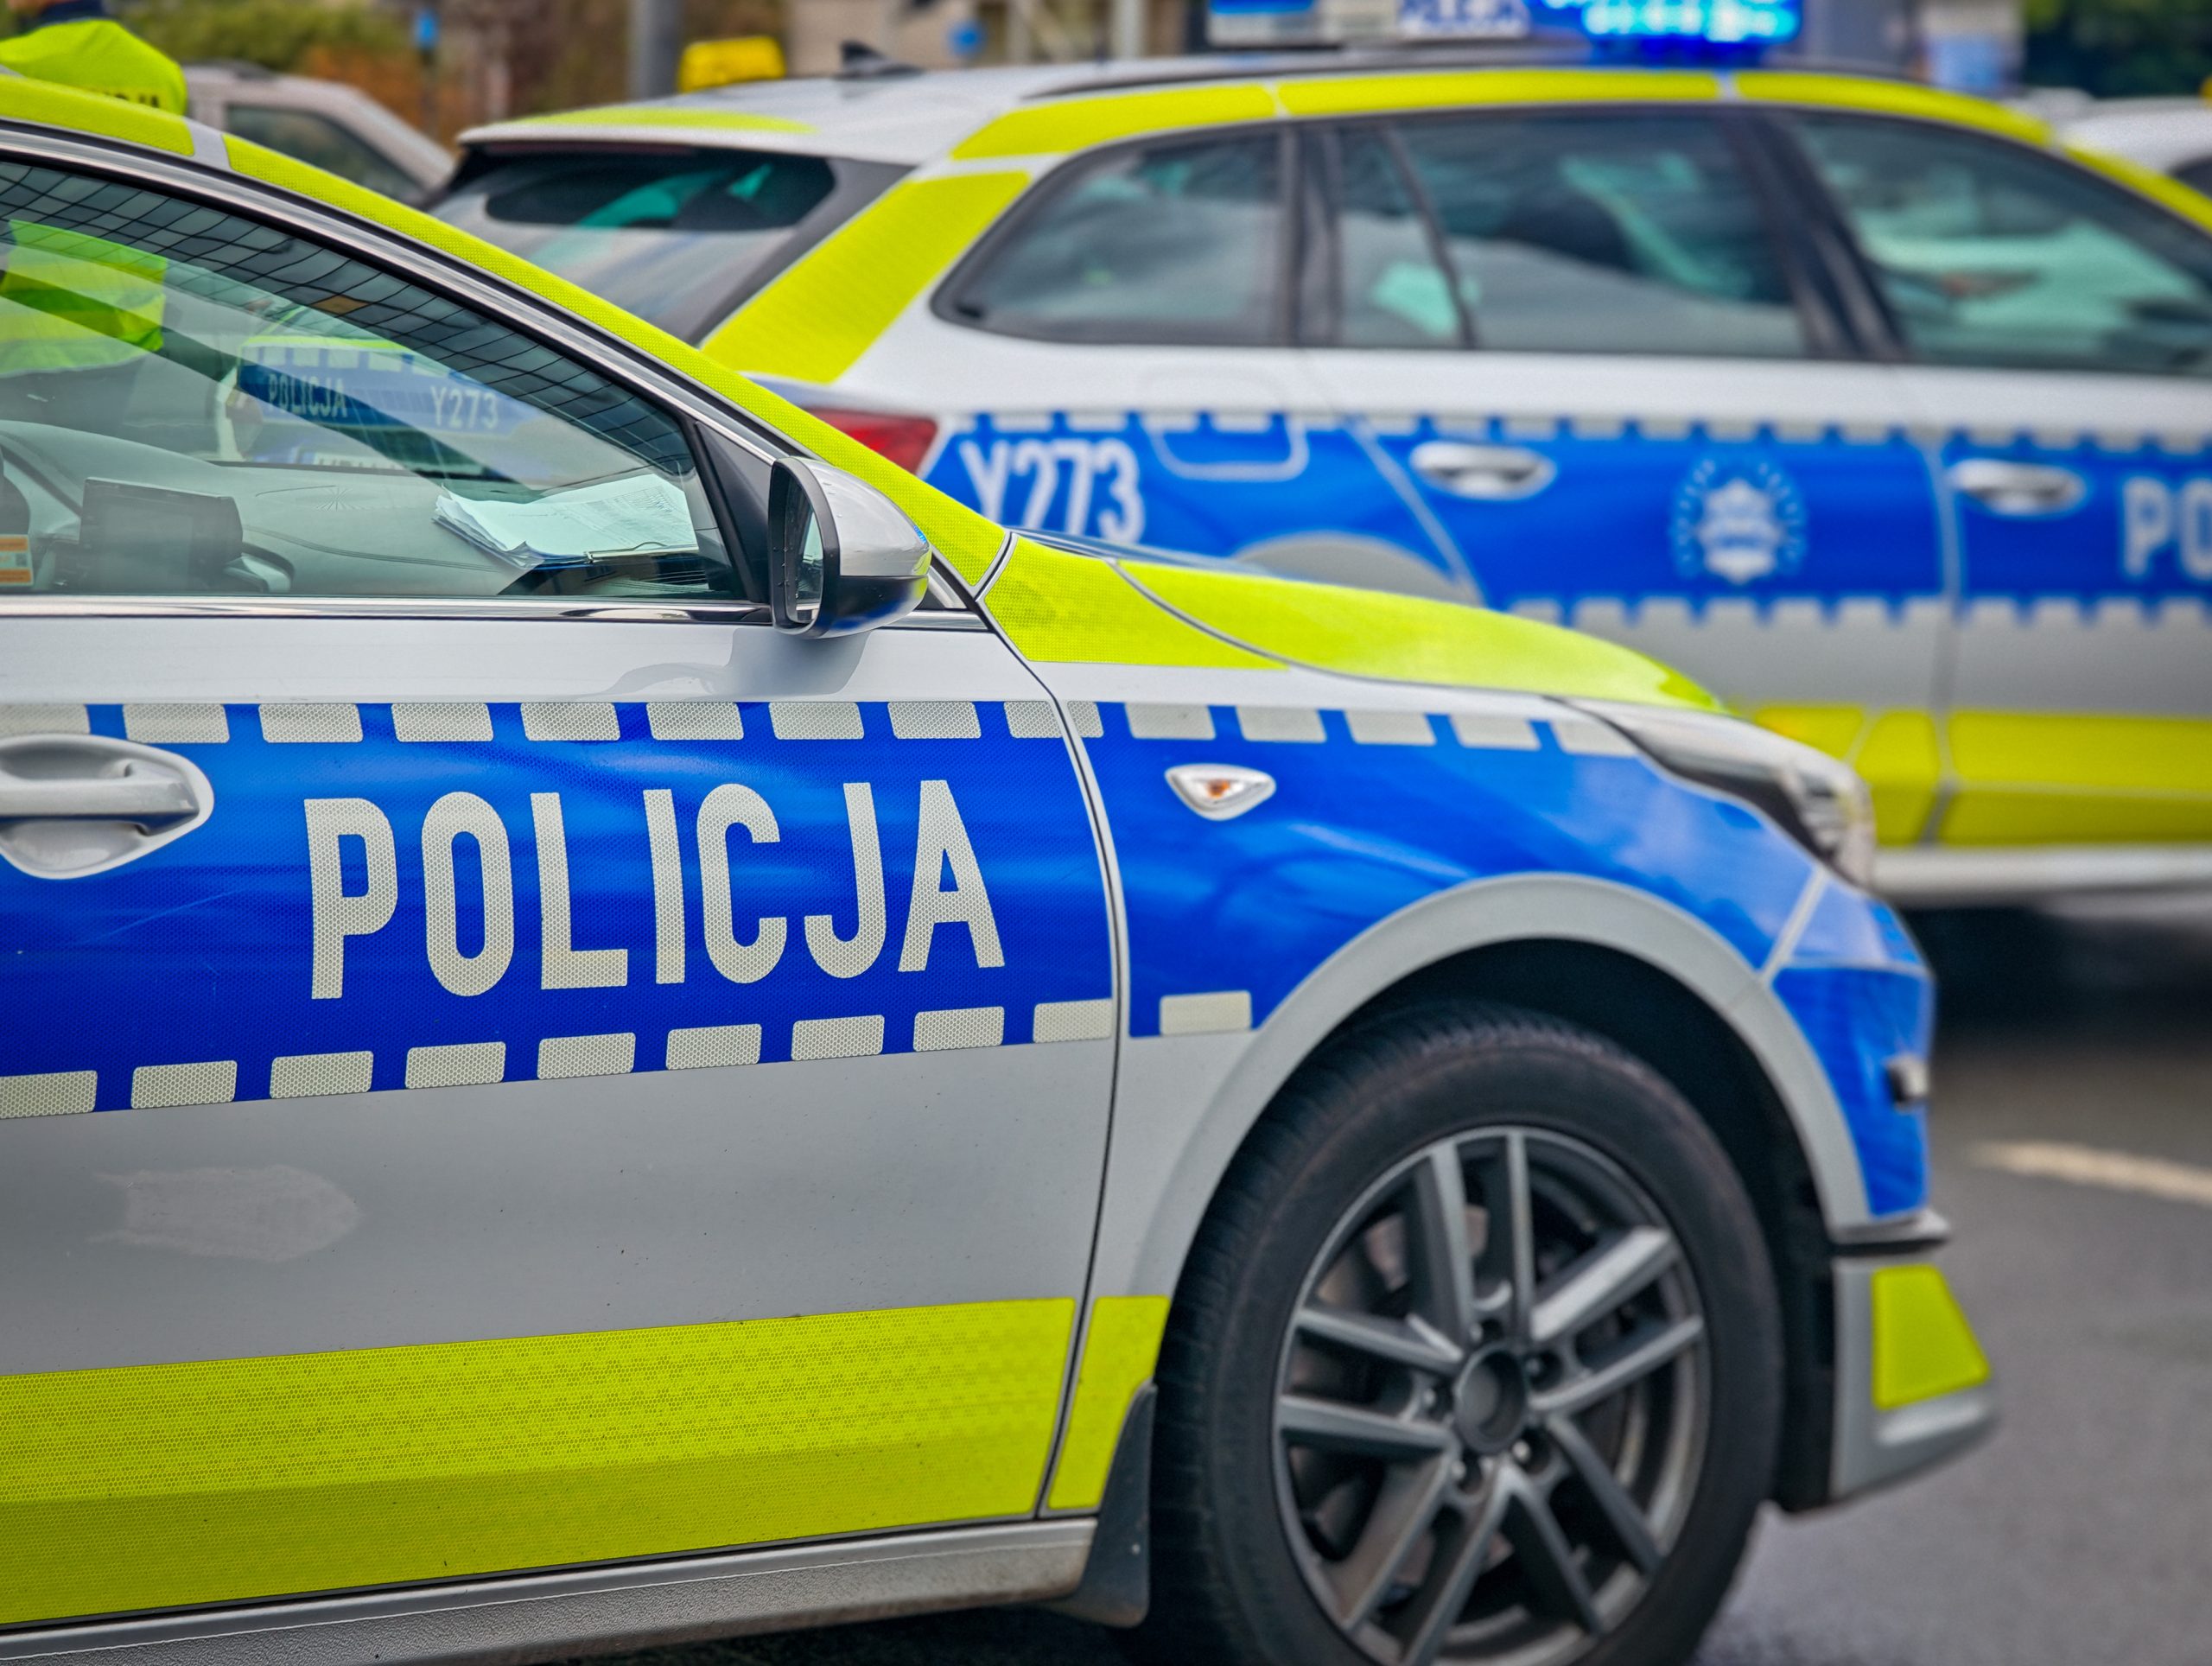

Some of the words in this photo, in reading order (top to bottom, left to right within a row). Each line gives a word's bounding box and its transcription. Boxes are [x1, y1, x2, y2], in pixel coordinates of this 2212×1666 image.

[268, 373, 347, 418] POLICJA
[431, 385, 499, 429] Y273
[960, 439, 1146, 544] Y273
[304, 779, 1005, 999] POLICJA
